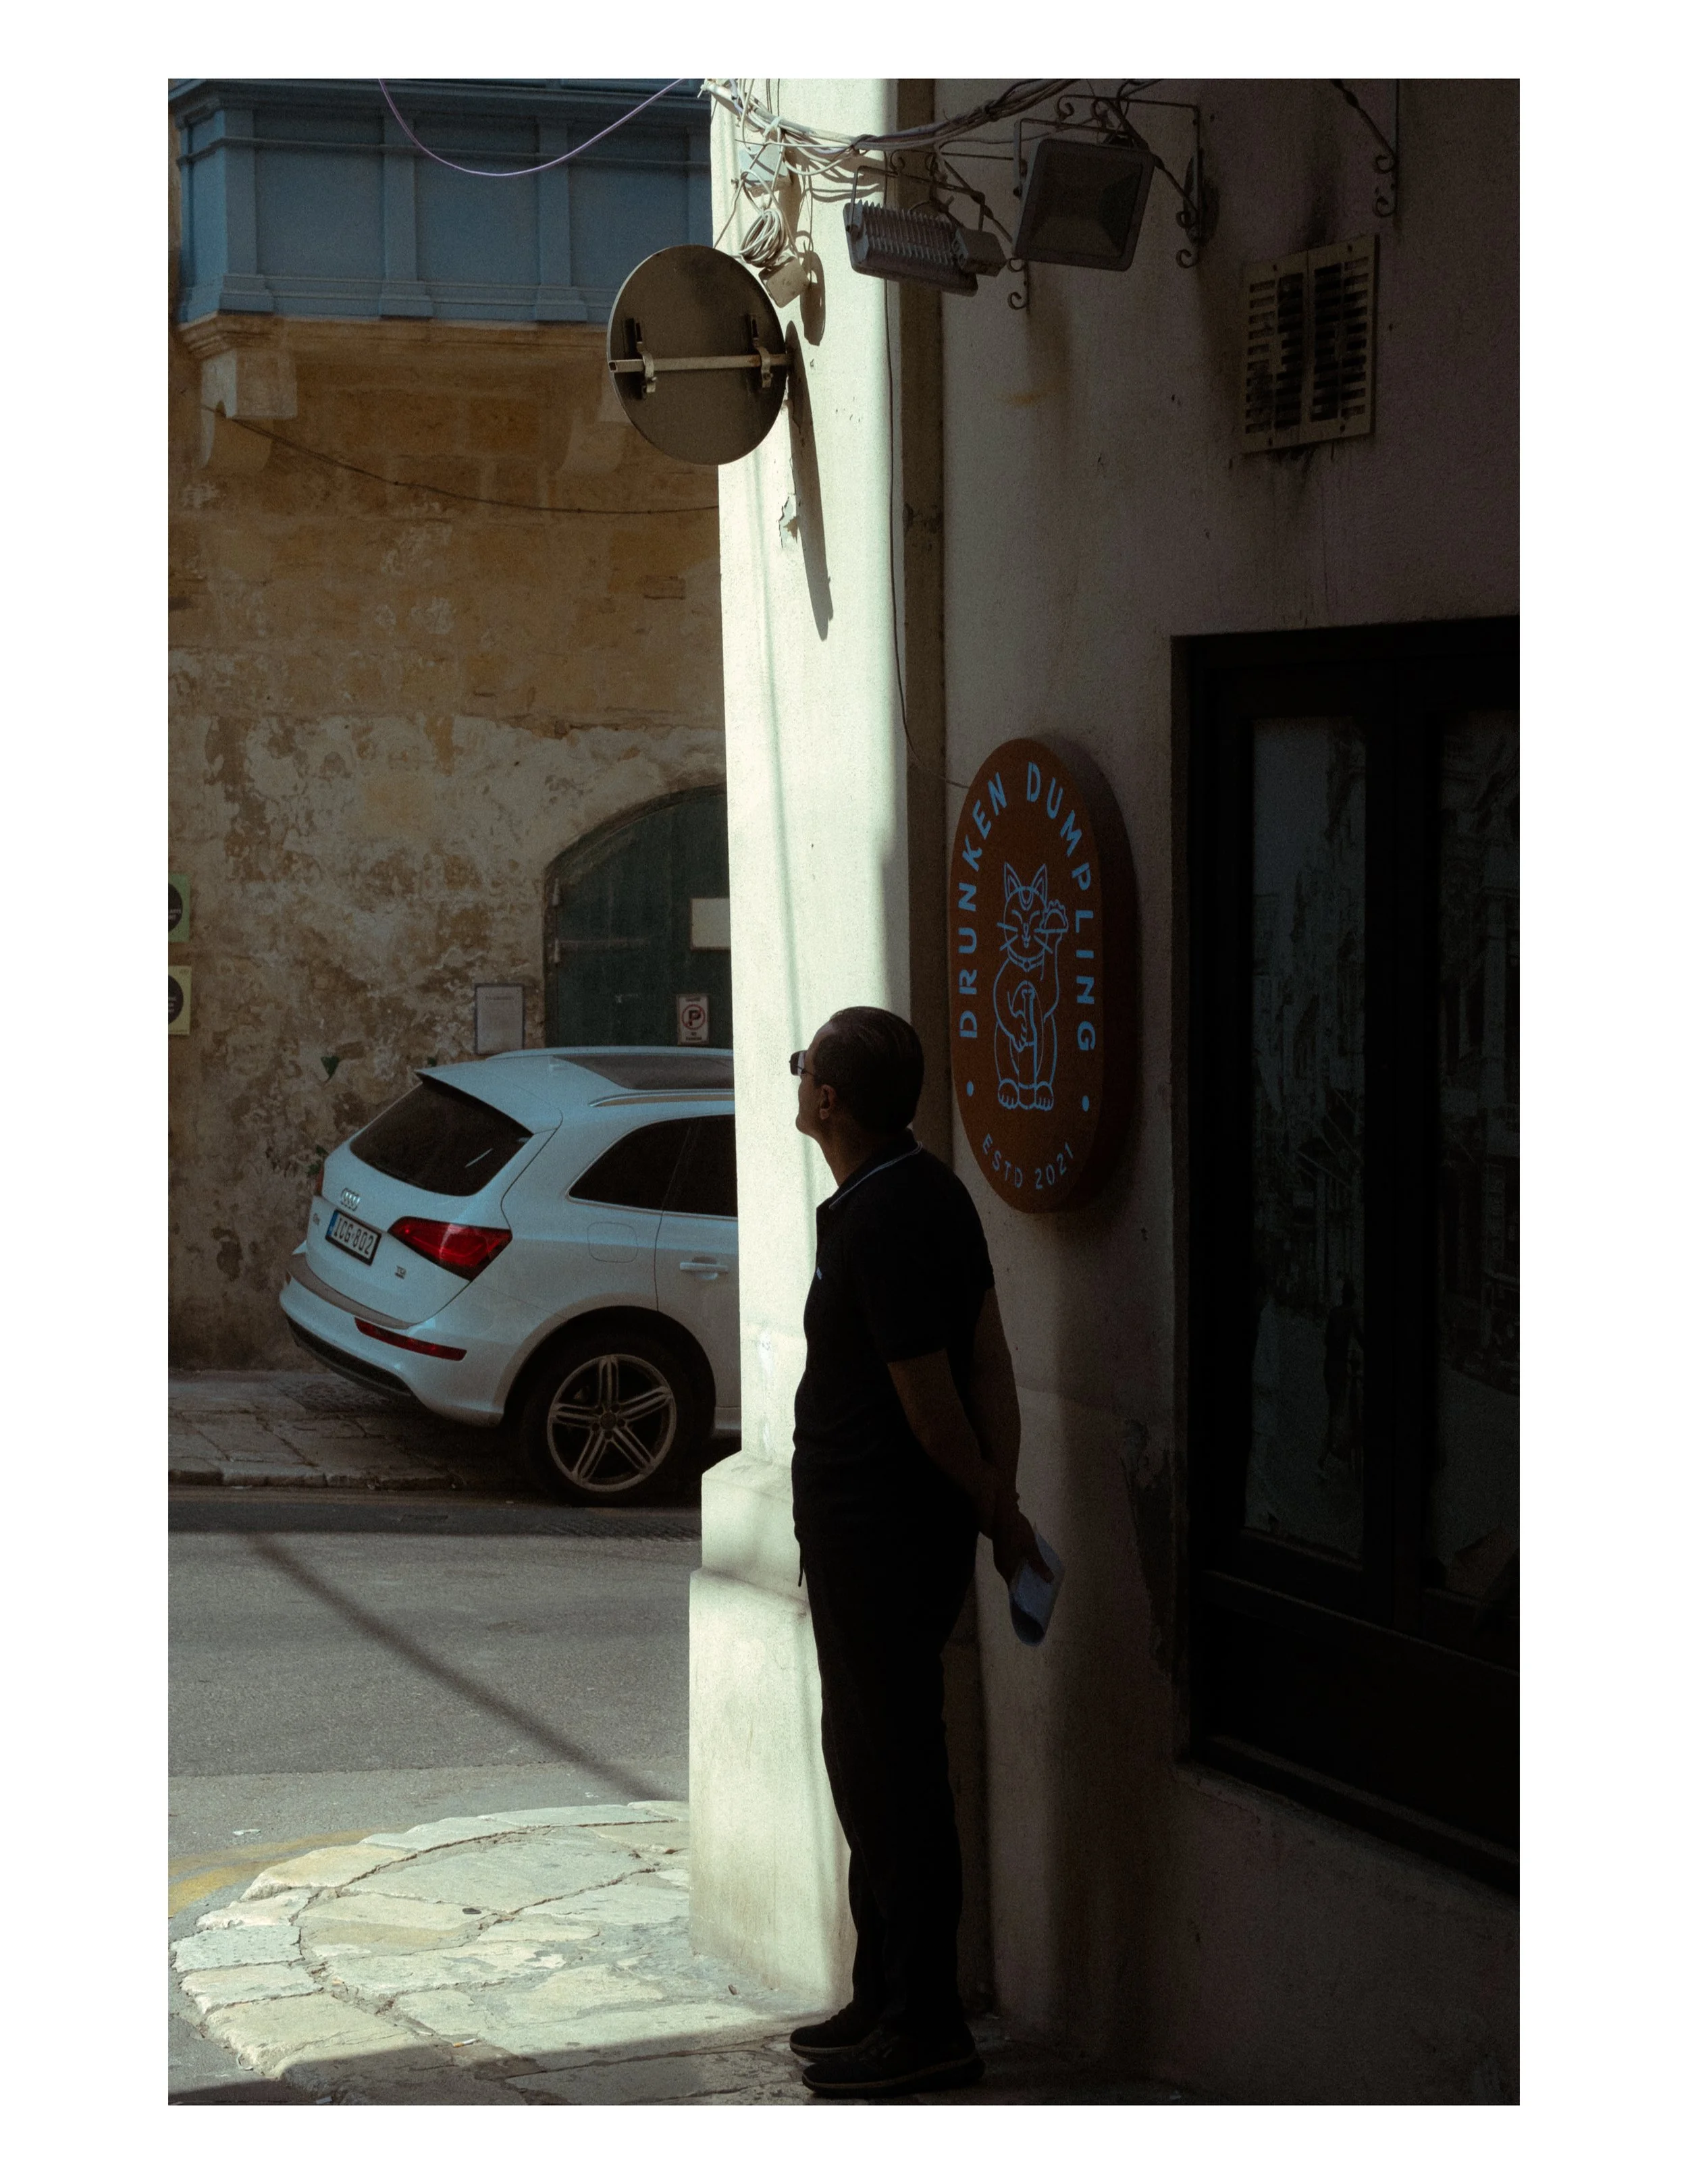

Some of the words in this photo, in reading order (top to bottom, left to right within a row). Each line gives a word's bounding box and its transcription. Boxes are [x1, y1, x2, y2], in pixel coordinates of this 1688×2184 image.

[957, 772, 1007, 1038] DRUNKEN
[1026, 762, 1097, 1052] DUMPLING
[982, 1133, 1023, 1188] ESTD
[1034, 1141, 1074, 1190] 2021
